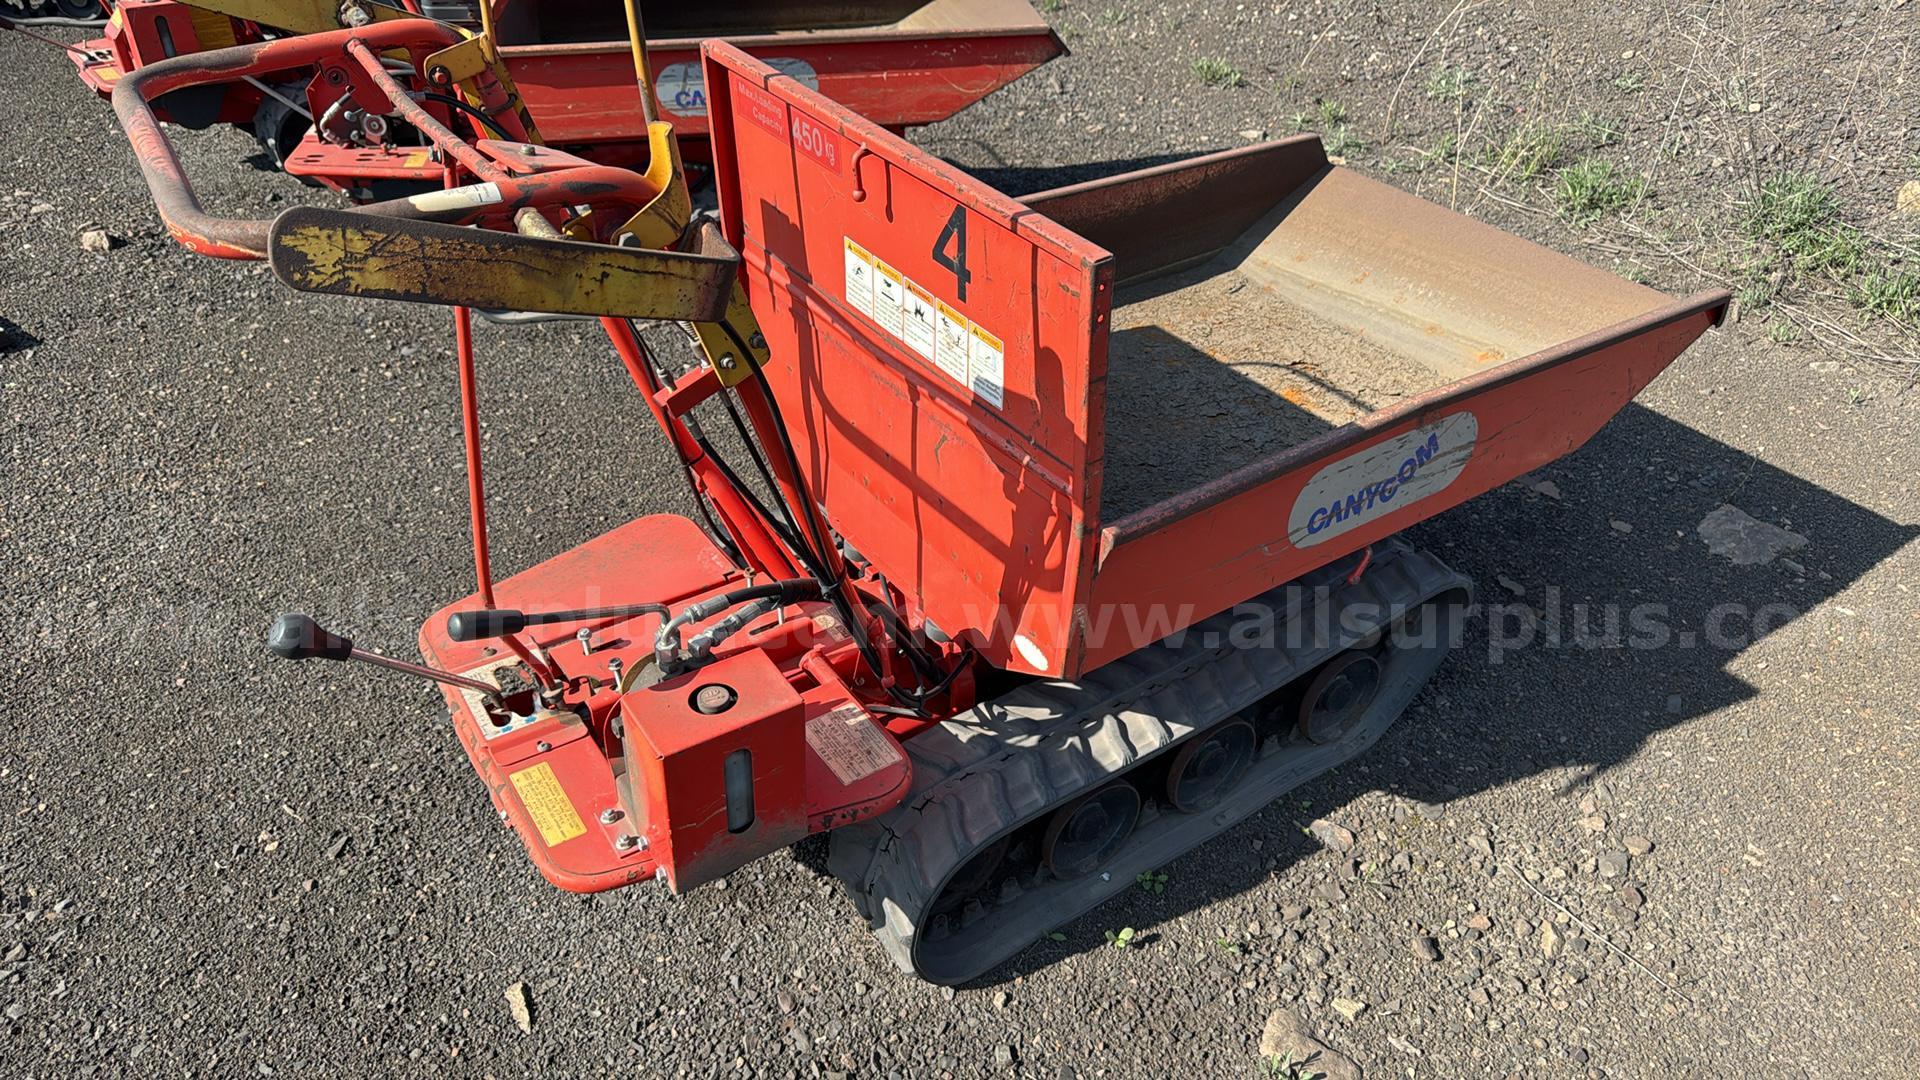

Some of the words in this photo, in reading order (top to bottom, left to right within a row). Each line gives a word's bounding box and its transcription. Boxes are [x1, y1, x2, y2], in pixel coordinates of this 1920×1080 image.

[752, 106, 783, 136] Capacity
[791, 116, 822, 158] 450
[823, 133, 835, 167] kg
[932, 204, 971, 303] 4
[1306, 432, 1440, 535] CANYCOM
